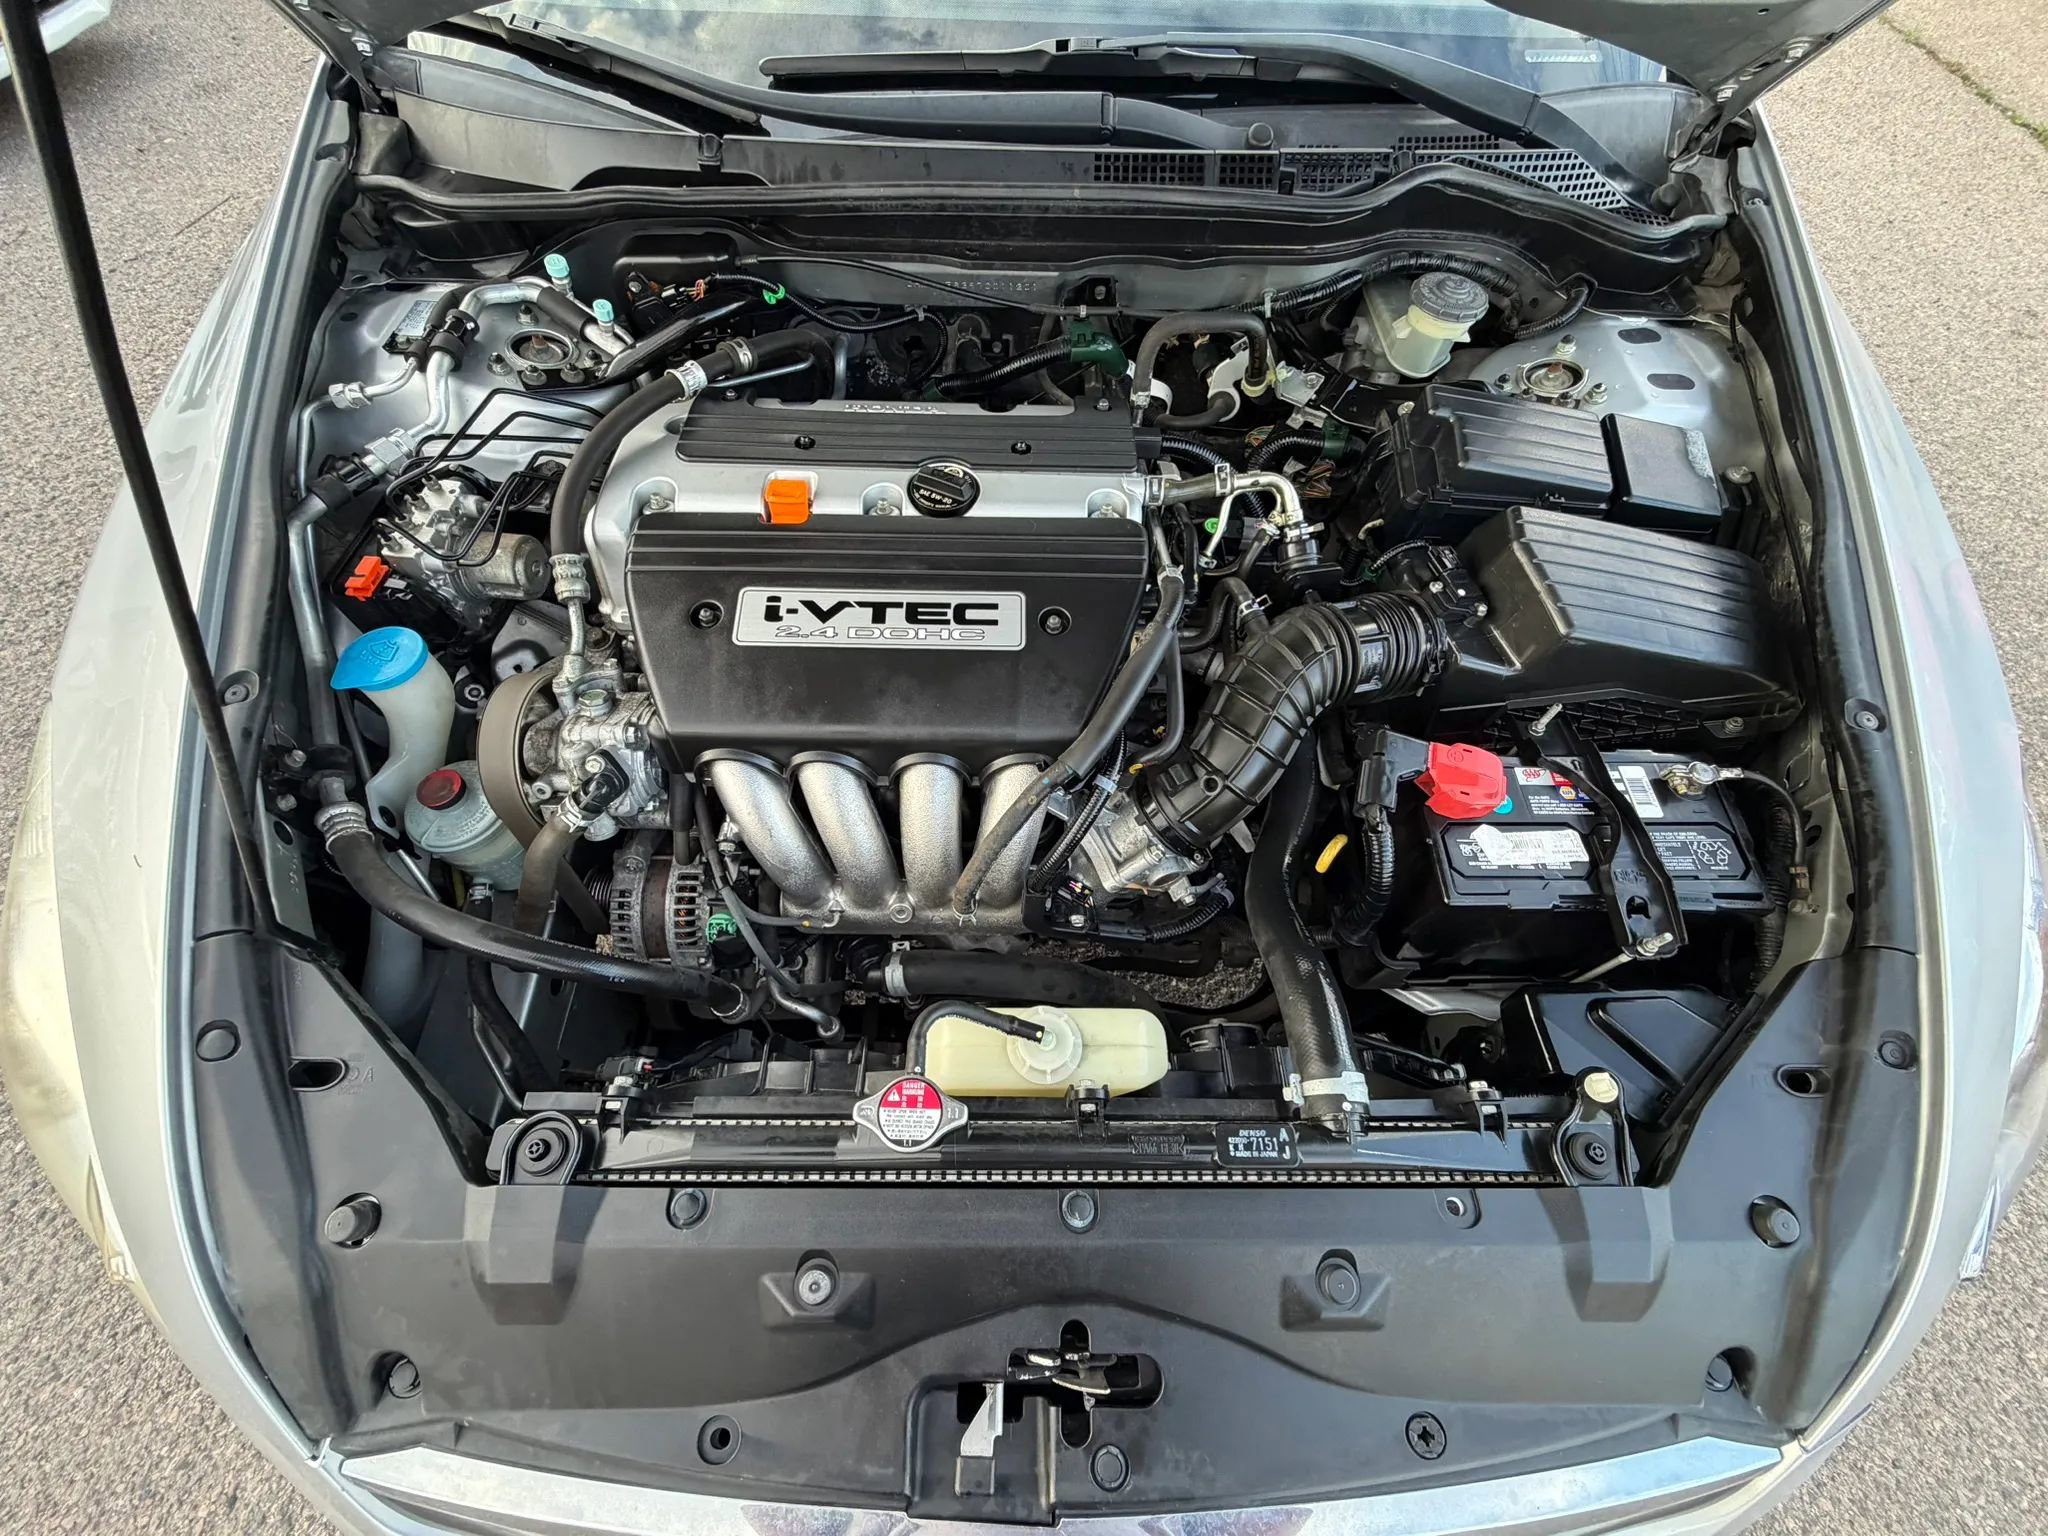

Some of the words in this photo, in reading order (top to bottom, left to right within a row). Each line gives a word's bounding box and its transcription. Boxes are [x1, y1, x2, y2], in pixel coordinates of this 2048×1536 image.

[919, 488, 932, 498] SAE
[931, 493, 953, 505] 5W-20
[763, 595, 999, 625] i-VTEC
[774, 625, 838, 639] 2.4
[847, 626, 985, 641] DOHC
[1238, 1129, 1266, 1137] DENSO
[1279, 1127, 1290, 1142] A
[1282, 1145, 1291, 1160] J
